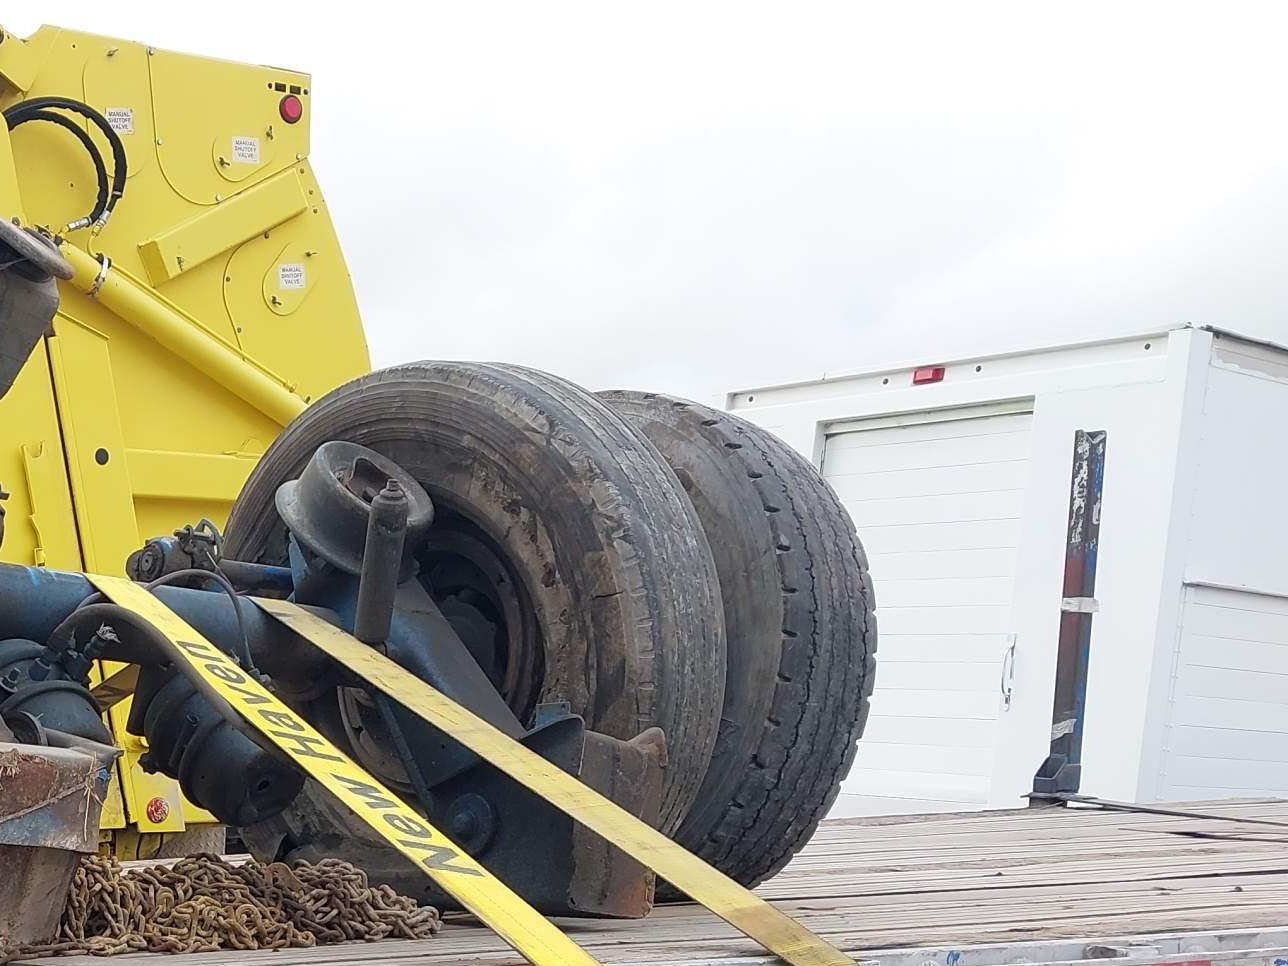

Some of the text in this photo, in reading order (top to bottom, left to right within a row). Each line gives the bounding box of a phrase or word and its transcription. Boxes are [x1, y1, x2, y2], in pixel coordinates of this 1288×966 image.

[234, 145, 257, 153] SHUTOFF
[175, 638, 482, 878] New Haven
